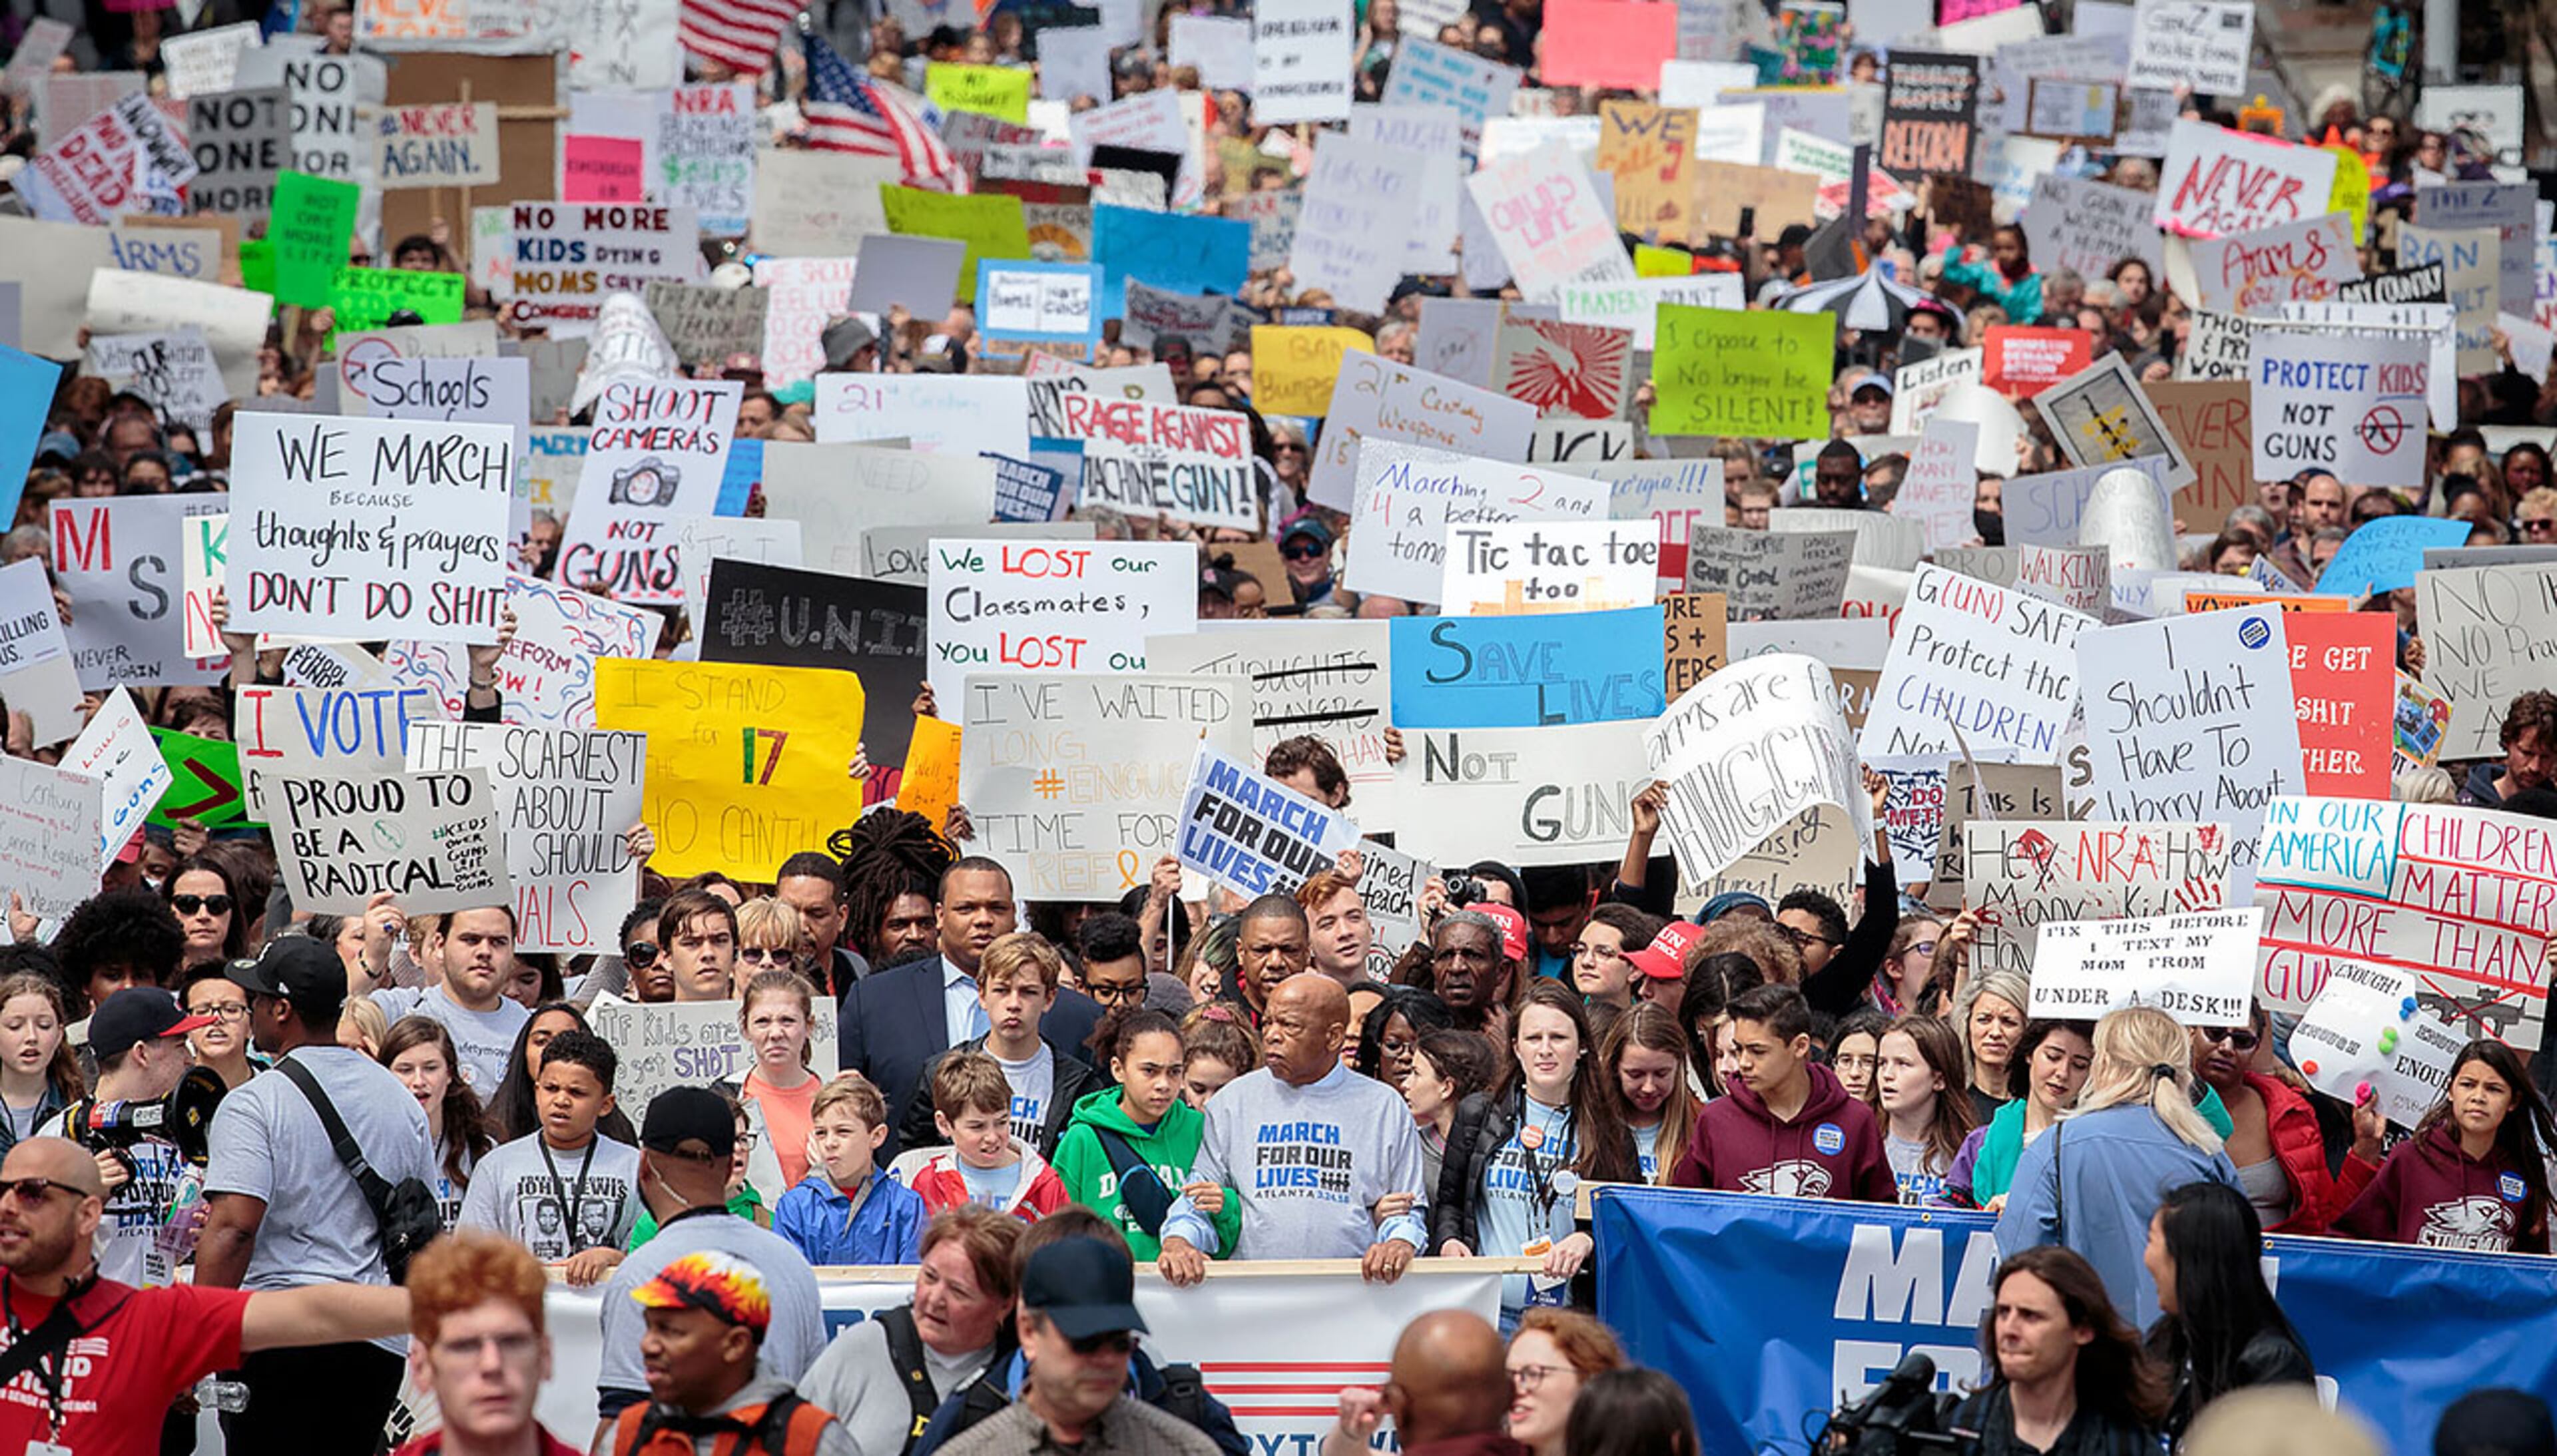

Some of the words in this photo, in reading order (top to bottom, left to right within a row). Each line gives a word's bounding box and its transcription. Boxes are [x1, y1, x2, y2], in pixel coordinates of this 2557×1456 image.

[285, 63, 344, 91] NO
[194, 98, 278, 129] NOT
[673, 89, 736, 115] NRA
[380, 105, 478, 136] #NEVER
[1610, 108, 1688, 142] WE
[194, 138, 278, 173] ONE
[2171, 154, 2303, 218] NEVER
[514, 208, 555, 230] NO
[584, 208, 670, 231] MORE
[517, 239, 586, 262] KIDS
[595, 247, 661, 264] DYING
[513, 271, 597, 293] MOMS
[1771, 329, 1799, 356] to
[371, 359, 491, 409] Schools
[1678, 363, 1711, 387] No
[1902, 358, 1972, 391] Listen
[2263, 360, 2369, 392] PROTECT
[2378, 362, 2426, 394] KIDS
[605, 381, 729, 424] SHOOT
[1690, 393, 1815, 426] SILENT!
[2283, 403, 2335, 426] NOT
[591, 425, 719, 455] CAMERAS
[1064, 394, 1147, 445] RAGE
[1152, 407, 1244, 459] AGAINST
[276, 424, 350, 483] WE
[372, 433, 509, 492] MARCH
[2265, 435, 2337, 461] GUNS
[330, 490, 414, 508] BECAUSE
[1376, 464, 1488, 502] Marching
[1508, 475, 1545, 513] 2
[1554, 495, 1592, 513] and
[1372, 491, 1391, 528] 4
[1408, 507, 1424, 527] a
[54, 507, 112, 573] M
[251, 511, 371, 567] thoughts
[378, 516, 397, 568] &
[403, 527, 499, 573] prayers
[607, 520, 665, 542] NOT
[560, 542, 680, 591] GUNS
[940, 547, 985, 573] We
[1001, 547, 1091, 579] LOST
[1111, 557, 1158, 575] our
[1456, 531, 1510, 575] Tic
[1524, 532, 1590, 567] tac
[1602, 530, 1657, 566] toe
[2019, 544, 2108, 589] WALKING
[128, 555, 169, 620] S
[248, 571, 350, 616] DON'T
[365, 582, 411, 620] DO
[427, 583, 507, 628] SHIT
[946, 585, 1149, 620] Classmates,
[1525, 577, 1579, 600] too
[1916, 569, 2004, 624] G(UN)
[2432, 568, 2520, 626] NO
[73, 644, 131, 670] NEVER
[936, 642, 988, 665] you
[1000, 635, 1087, 670] LOST
[1426, 619, 1565, 684] SAVE
[1906, 624, 2013, 680] Protect
[2024, 660, 2072, 701] the
[2163, 625, 2175, 670] I
[2323, 645, 2373, 672] GET
[2433, 624, 2490, 667] NO
[107, 660, 162, 682] AGAIN
[2434, 668, 2500, 702] WE
[613, 666, 663, 709] I
[675, 670, 786, 714] STAND
[971, 682, 1065, 725] I'VE
[1093, 684, 1231, 724] WAITED
[1537, 669, 1664, 726] LIVES
[1725, 672, 1791, 718] are
[2106, 662, 2255, 734] Shouldn't
[243, 690, 284, 758] I
[1896, 674, 2056, 753] CHILDREN
[2295, 697, 2355, 727] SHIT
[499, 729, 646, 786] SCARIEST
[742, 726, 789, 786] 17
[988, 730, 1086, 767] LONG
[1424, 734, 1518, 784] NOT
[2117, 735, 2195, 782] Have
[2203, 724, 2251, 769] To
[284, 776, 405, 828] PROUD
[417, 774, 473, 808] TO
[512, 784, 613, 831] ABOUT
[1205, 758, 1329, 846] MARCH
[1912, 788, 1943, 806] DO
[2033, 788, 2052, 815] Is
[2215, 768, 2286, 811] About
[433, 816, 488, 840] #KIDS
[975, 812, 1085, 853] TIME
[1193, 792, 1264, 849] FOR
[1261, 827, 1335, 878] OUR
[2269, 800, 2300, 825] IN
[2319, 801, 2384, 837] OUR
[293, 828, 330, 858] BE
[337, 828, 364, 855] A
[445, 833, 483, 849] OVER
[447, 844, 488, 861] GUNS
[532, 833, 632, 876] SHOULD
[1968, 828, 2059, 892] Hey
[2076, 824, 2159, 883] NRA
[2165, 830, 2229, 882] How
[2263, 830, 2391, 886] AMERICA
[303, 857, 455, 899] RADICAL
[1182, 825, 1276, 895] LIVES
[456, 876, 494, 893] GUNS
[2399, 863, 2556, 933] MATTER
[2046, 923, 2082, 939] FIX
[2100, 921, 2151, 935] THIS
[2168, 913, 2249, 931] BEFORE
[2122, 937, 2175, 953] TEXT
[2185, 934, 2214, 949] MY
[2269, 890, 2397, 958] MORE
[2425, 916, 2549, 987] THAN
[2080, 959, 2126, 971] MOM
[2147, 955, 2206, 970] FROM
[2335, 963, 2403, 997] ENOUGH!
[2034, 987, 2110, 1005] UNDER
[2131, 989, 2141, 1005] A
[2161, 989, 2243, 1019] DESK!!!
[698, 1020, 741, 1045] are
[2297, 1021, 2362, 1057] ENOUGH
[673, 1045, 742, 1079] SHOT
[1257, 1121, 1340, 1145] MARCH
[1256, 1146, 1302, 1166] FOR
[1304, 1146, 1352, 1170] OUR
[1255, 1188, 1315, 1199] ATLANTA
[1256, 1167, 1319, 1189] LIVES
